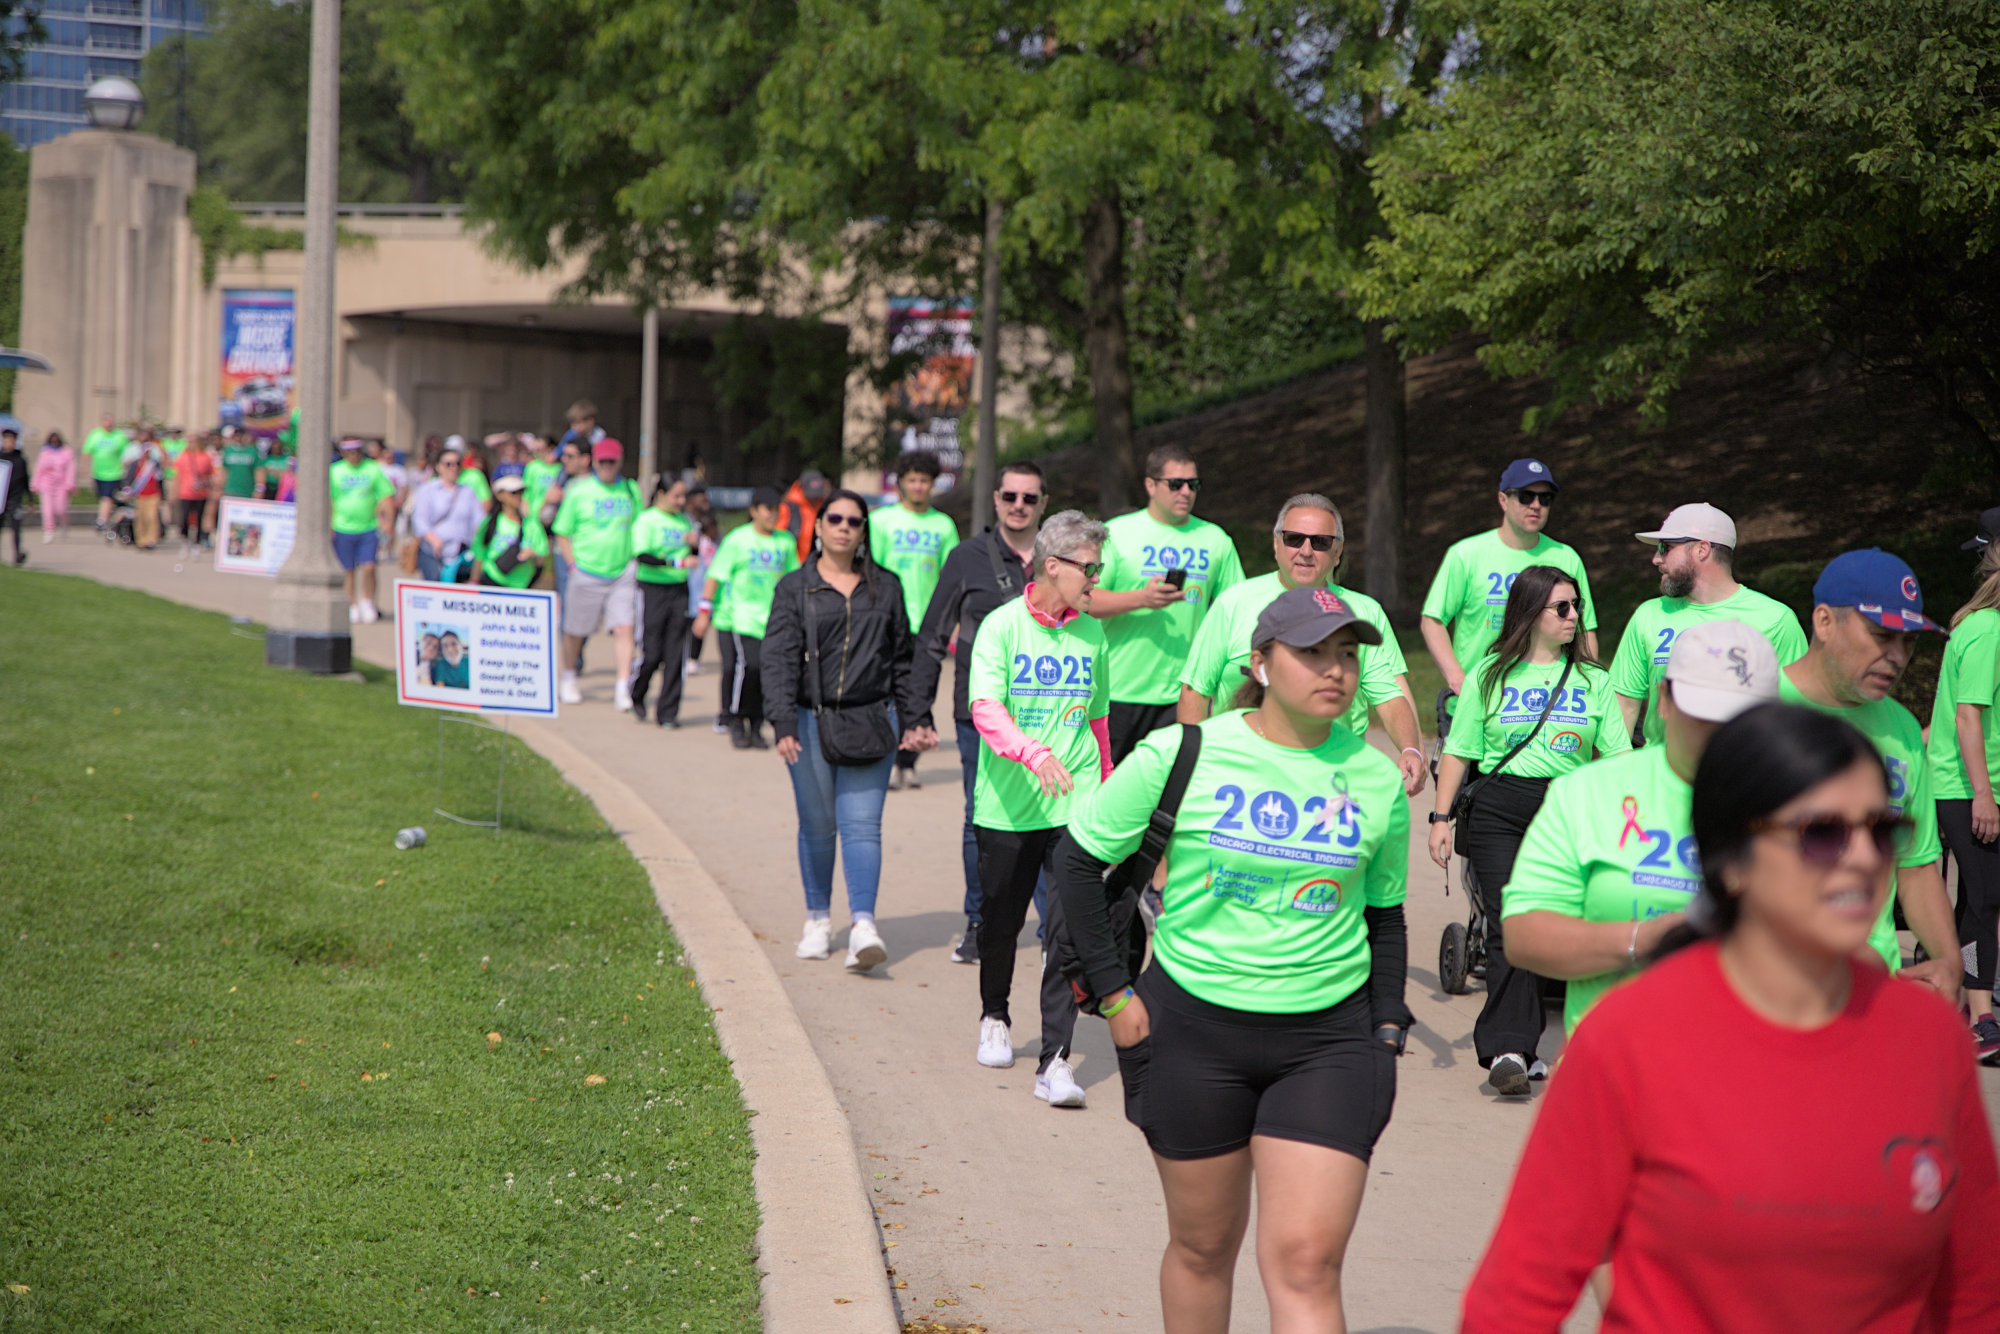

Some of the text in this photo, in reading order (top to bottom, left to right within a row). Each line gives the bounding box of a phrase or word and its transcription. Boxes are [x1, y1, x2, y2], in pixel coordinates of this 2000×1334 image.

[1142, 545, 1209, 571] 2025
[1901, 575, 1918, 601] C
[442, 599, 502, 616] MISSION
[505, 605, 537, 618] MILE
[480, 622, 541, 636] John & Niki
[479, 657, 540, 670] Keep Up The
[1013, 653, 1093, 686] 2025
[479, 672, 535, 686] Good Fight,
[479, 687, 538, 699] Mom & Dad
[1501, 686, 1587, 714] 2025
[1019, 706, 1053, 714] American
[1018, 721, 1045, 729] Society
[1529, 714, 1558, 722] ELECCAL
[1559, 716, 1587, 725] INDUSTRY
[1212, 784, 1361, 848] 2025
[1211, 833, 1357, 868] CHICAGO ELECTRICAL INDUSTRY
[1217, 864, 1274, 885] American
[1214, 876, 1258, 893] Cancer
[1213, 887, 1258, 906] Society
[1293, 900, 1317, 911] WALK
[1317, 903, 1325, 912] &
